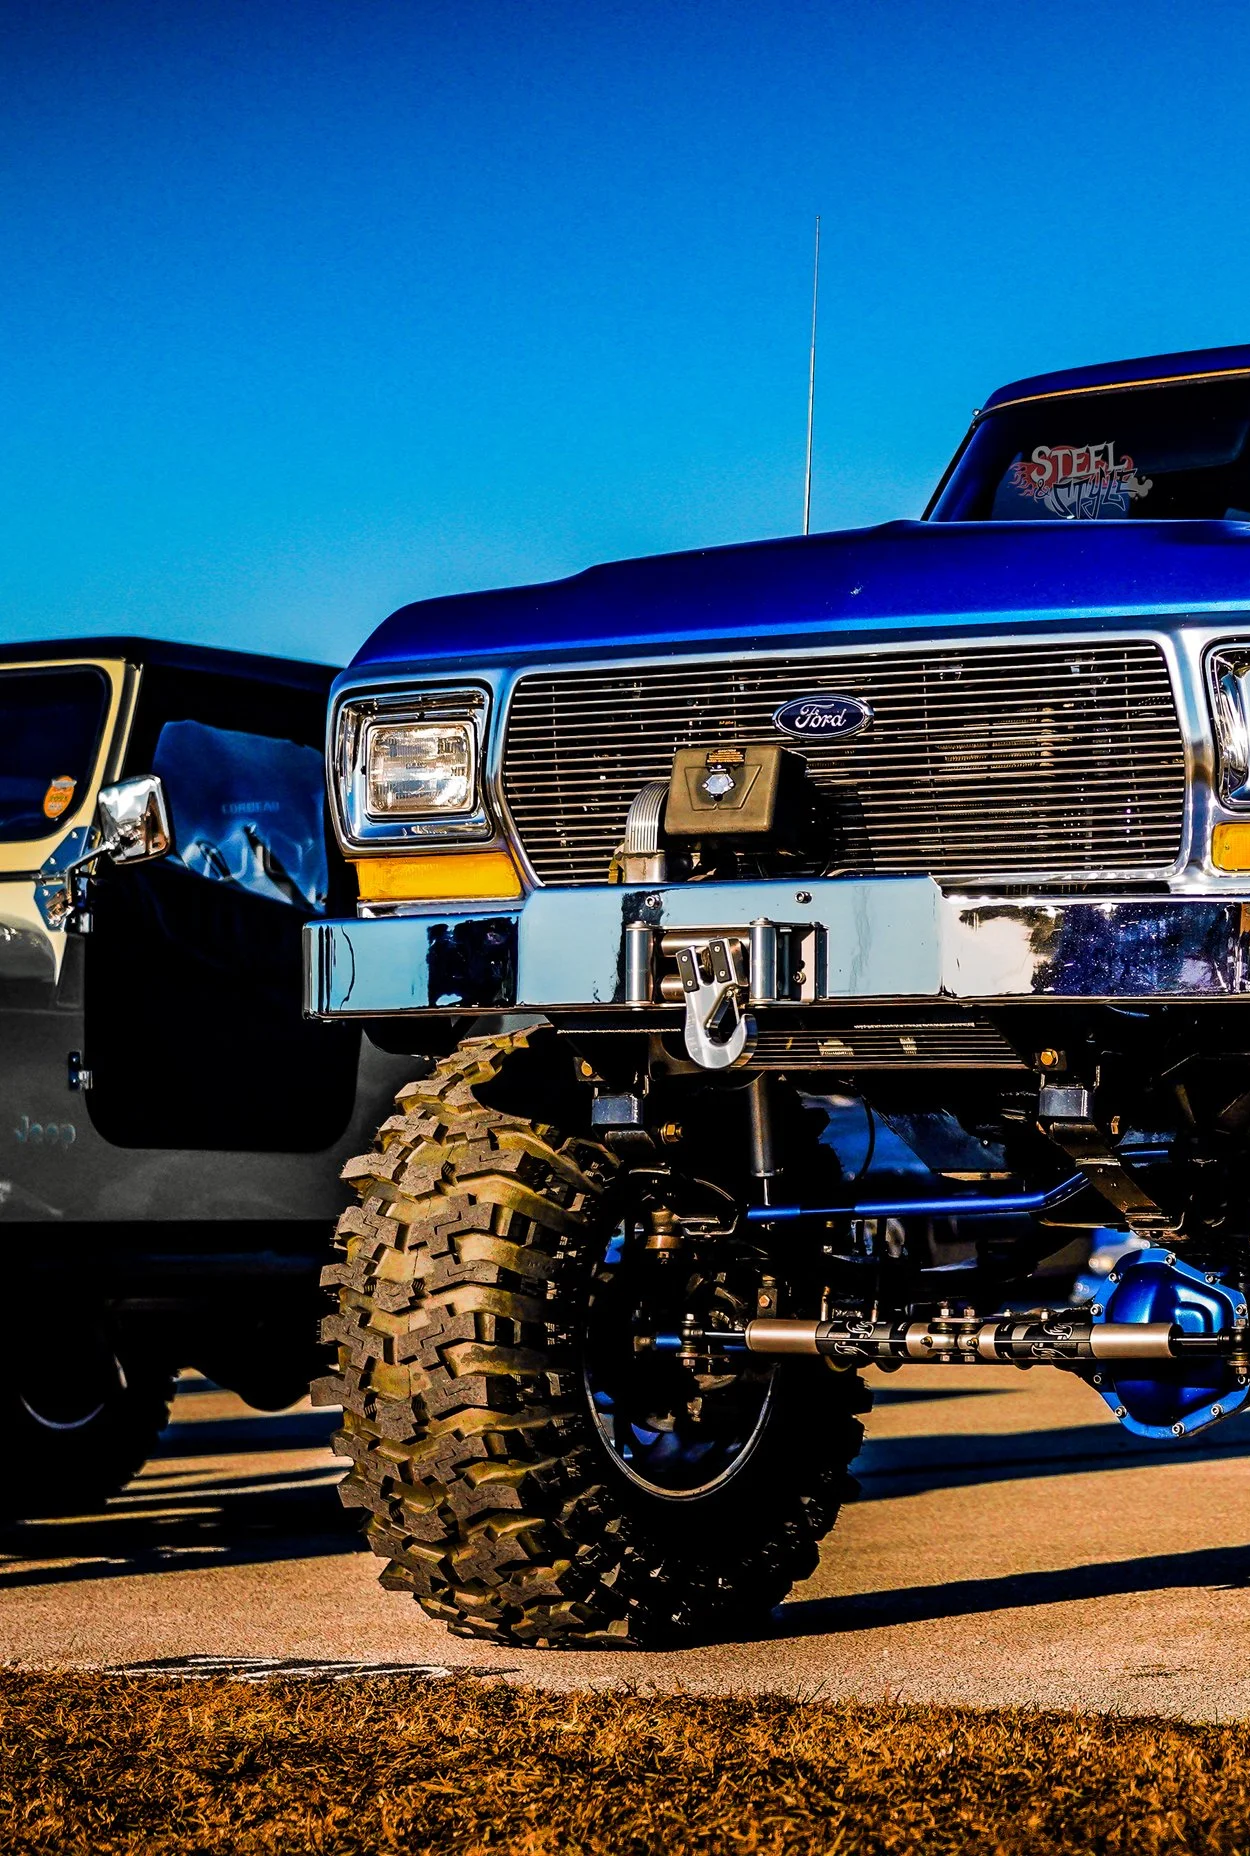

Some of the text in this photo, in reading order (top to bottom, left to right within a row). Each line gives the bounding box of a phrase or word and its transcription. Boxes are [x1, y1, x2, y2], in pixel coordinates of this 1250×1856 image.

[1031, 441, 1128, 483] STEEL
[1034, 467, 1138, 520] & STYLE
[795, 703, 847, 728] Ford
[14, 1115, 76, 1149] Jeep
